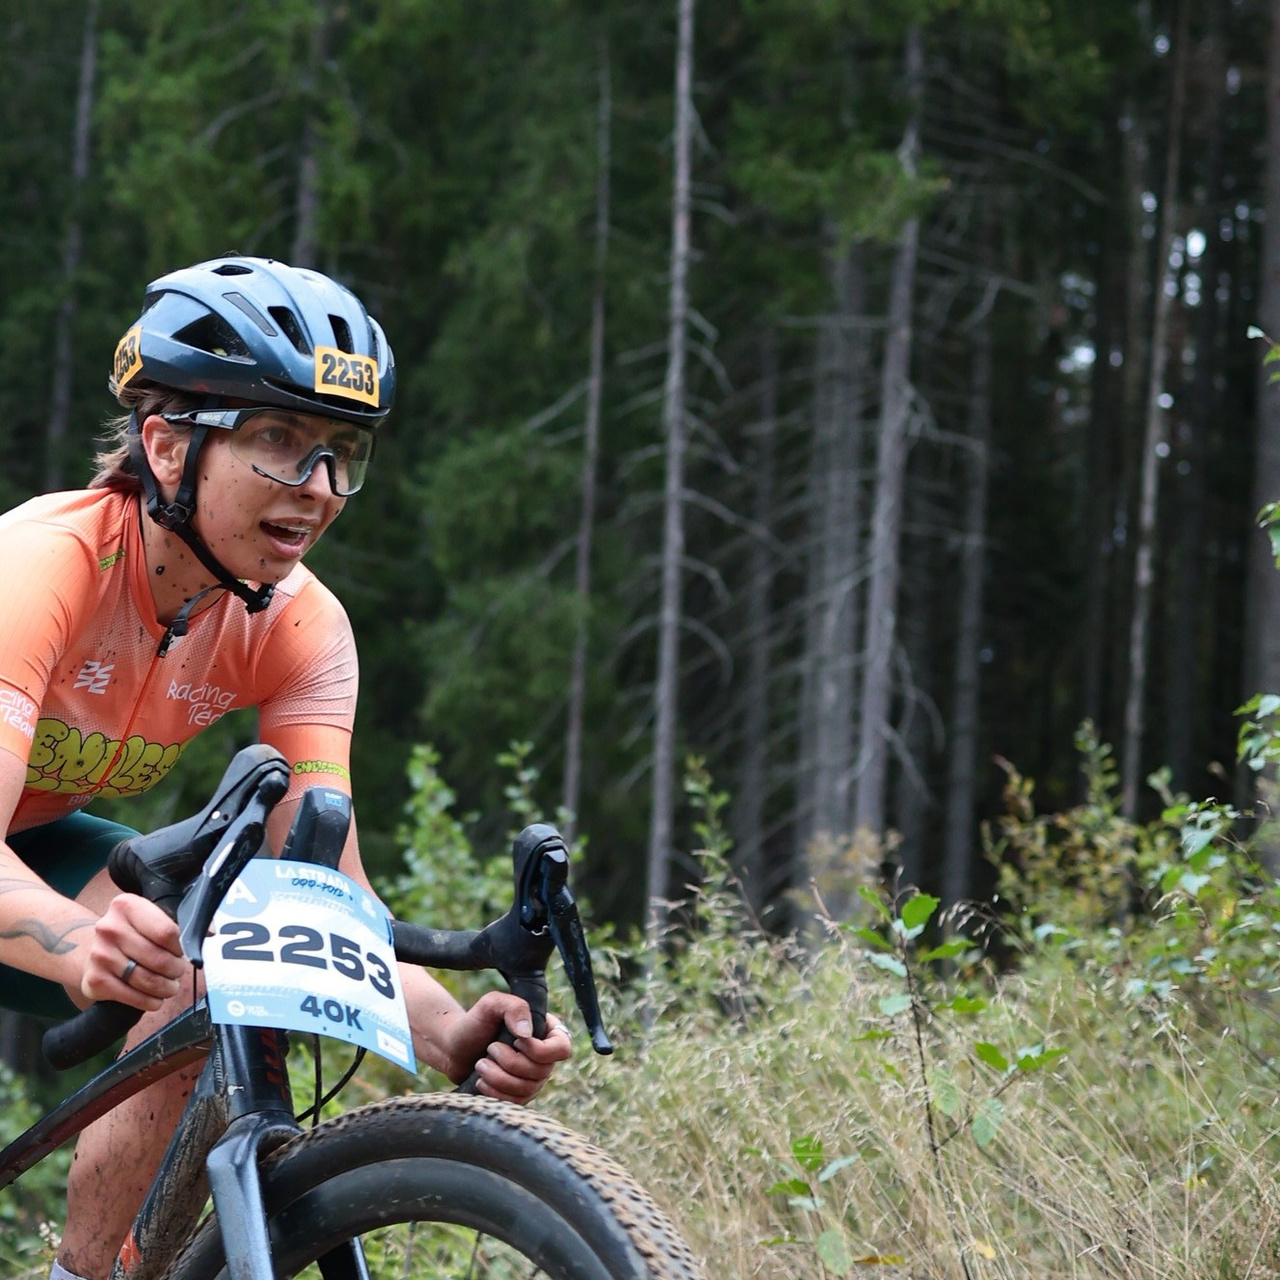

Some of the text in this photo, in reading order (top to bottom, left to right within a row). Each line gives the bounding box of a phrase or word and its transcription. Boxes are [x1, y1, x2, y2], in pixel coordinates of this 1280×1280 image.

[321, 353, 375, 396] 2253
[166, 678, 237, 708] Racing
[187, 702, 223, 726] Tea
[225, 877, 258, 905] A
[275, 865, 351, 895] LA STRADA
[220, 922, 396, 1000] 2253
[300, 995, 365, 1032] 40K
